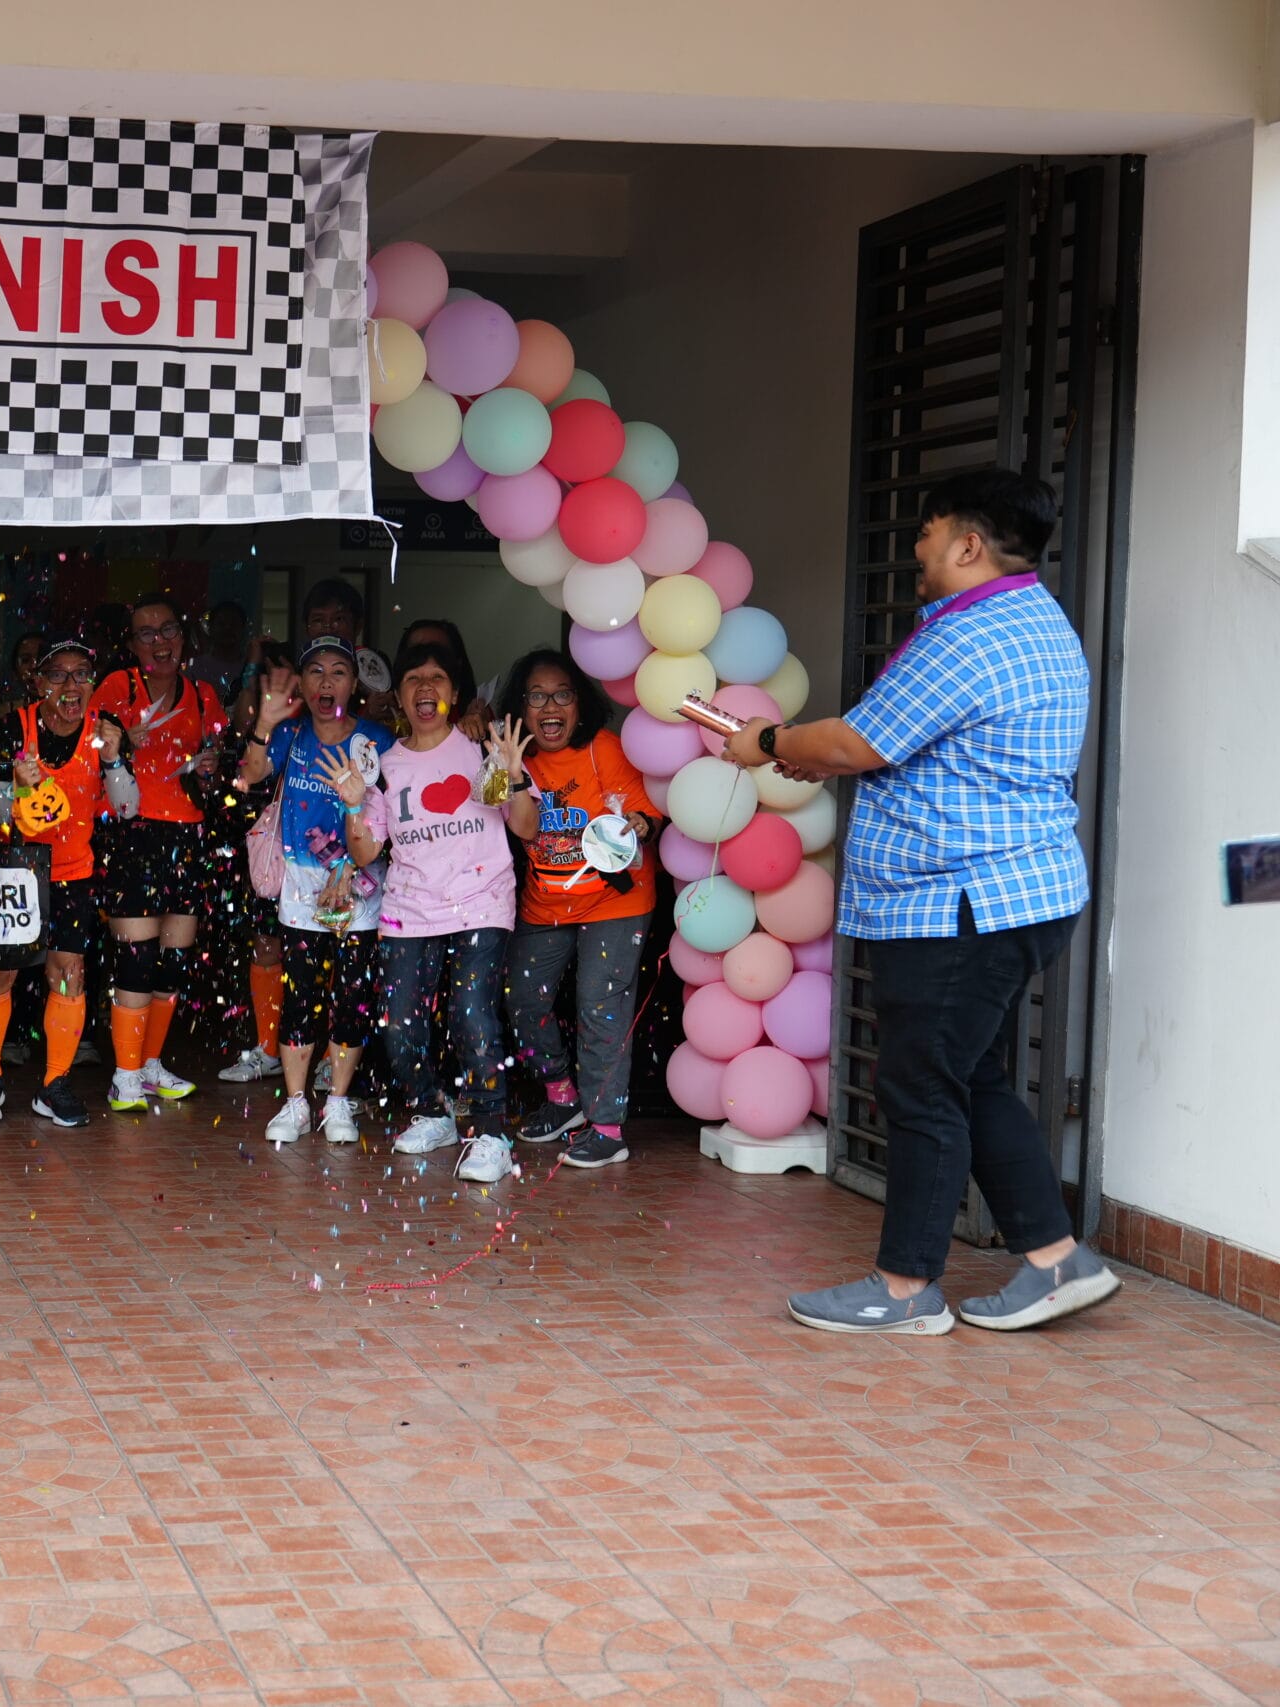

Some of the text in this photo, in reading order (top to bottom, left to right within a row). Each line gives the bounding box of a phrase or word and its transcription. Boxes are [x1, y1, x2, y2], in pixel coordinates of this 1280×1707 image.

[376, 507, 405, 516] ANTIN
[420, 531, 445, 540] AULA
[398, 786, 414, 823] I
